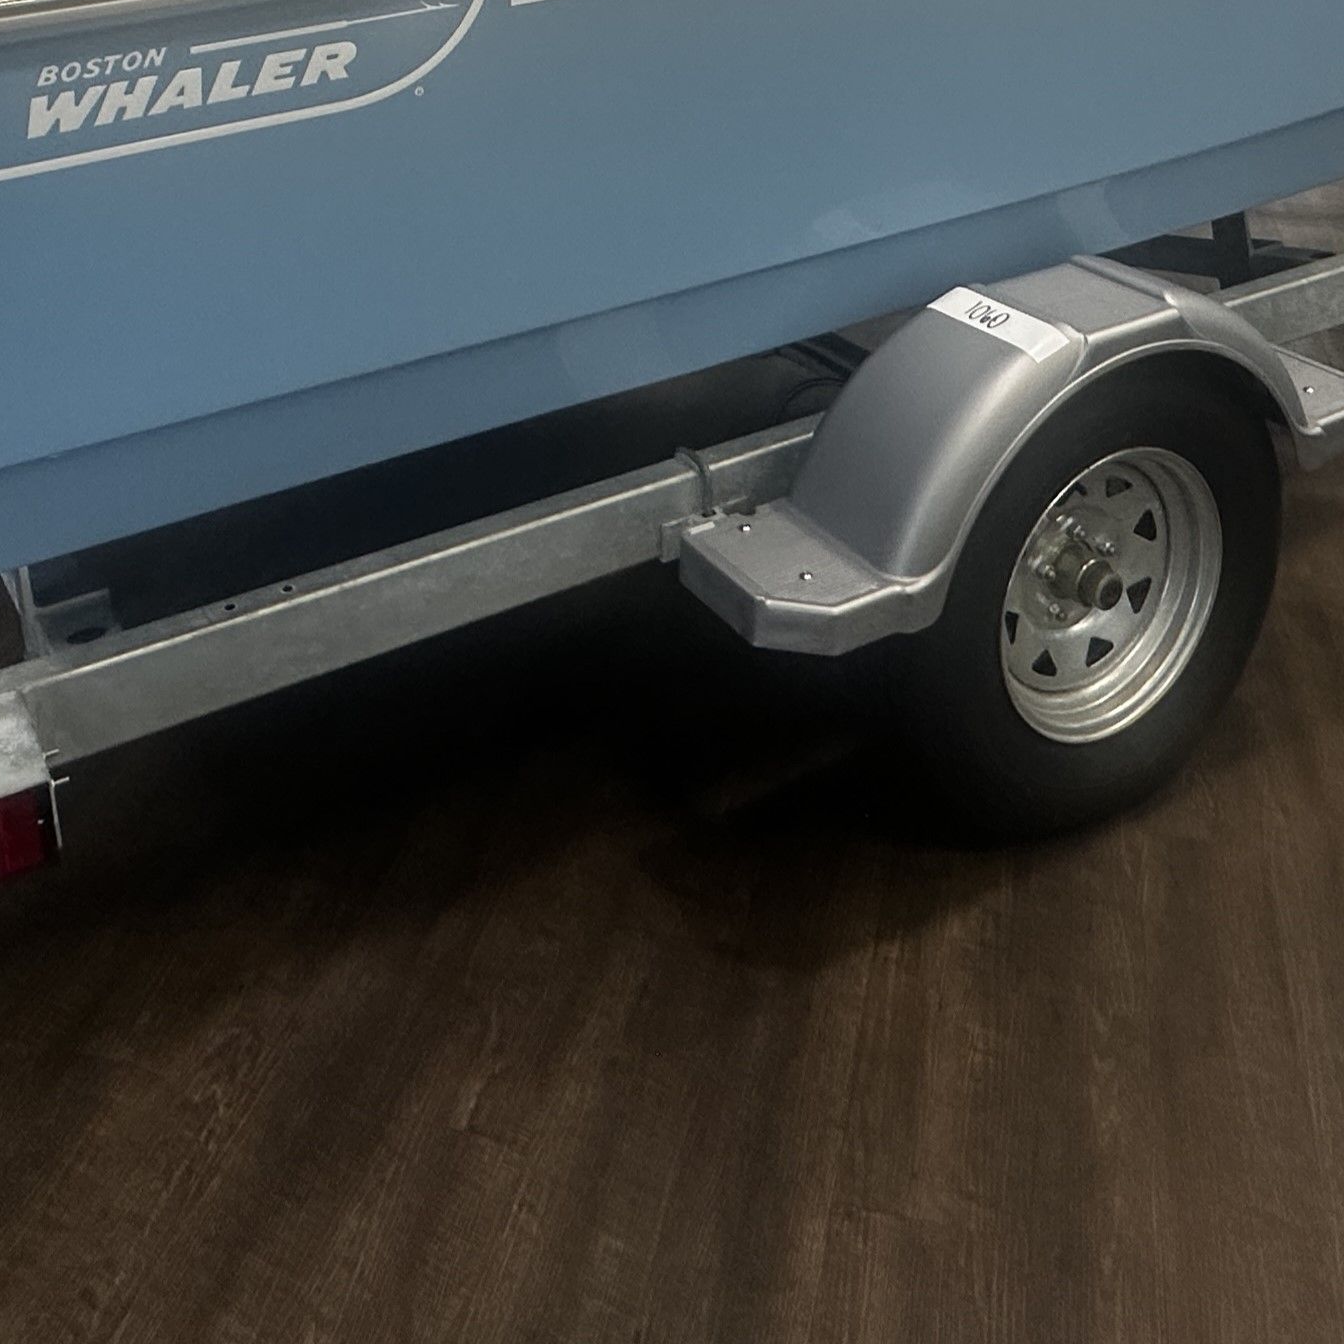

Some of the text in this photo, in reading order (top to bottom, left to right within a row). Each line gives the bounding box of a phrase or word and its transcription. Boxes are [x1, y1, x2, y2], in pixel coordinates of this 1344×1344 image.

[37, 47, 167, 87] BOSTON
[27, 40, 357, 140] WHALER
[964, 300, 1010, 329] 1060
